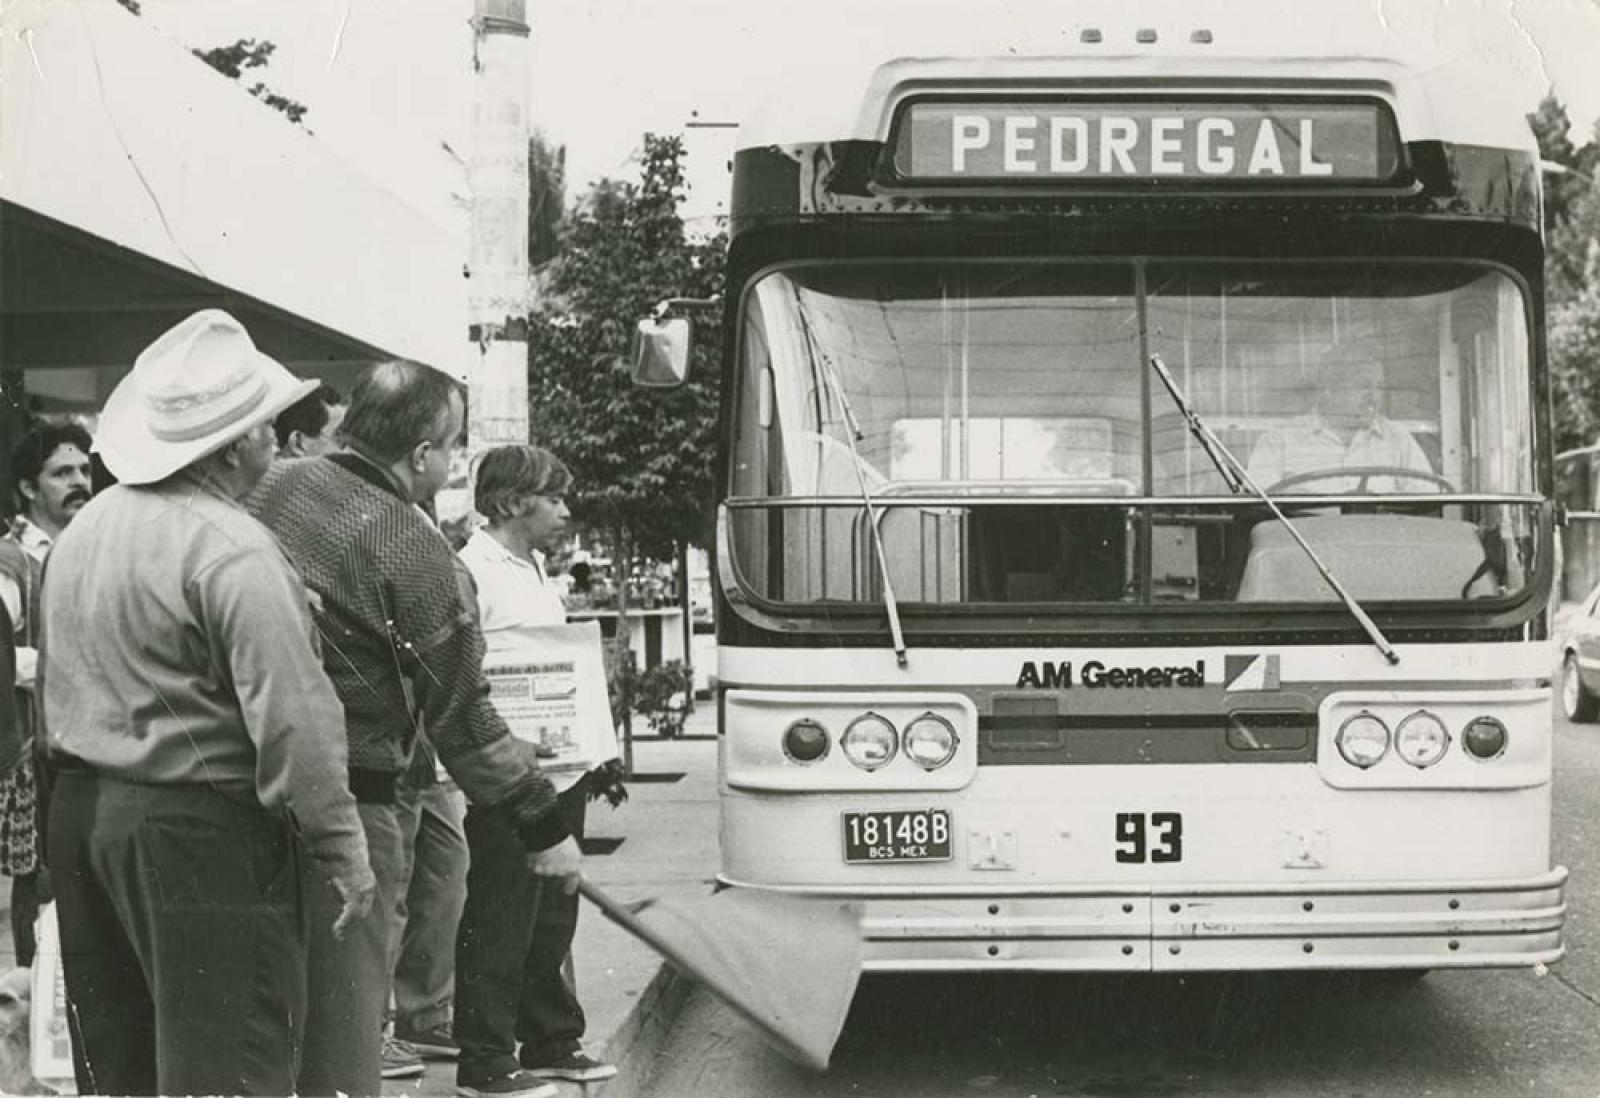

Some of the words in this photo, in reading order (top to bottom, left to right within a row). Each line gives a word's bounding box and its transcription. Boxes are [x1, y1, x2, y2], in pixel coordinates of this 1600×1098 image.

[952, 115, 1333, 175] PEDREGAL
[1016, 661, 1072, 689] AM
[1081, 660, 1205, 689] General
[850, 813, 948, 846] 18148B
[1115, 812, 1182, 863] 93
[869, 846, 895, 858] BCS
[901, 845, 928, 857] MEX
